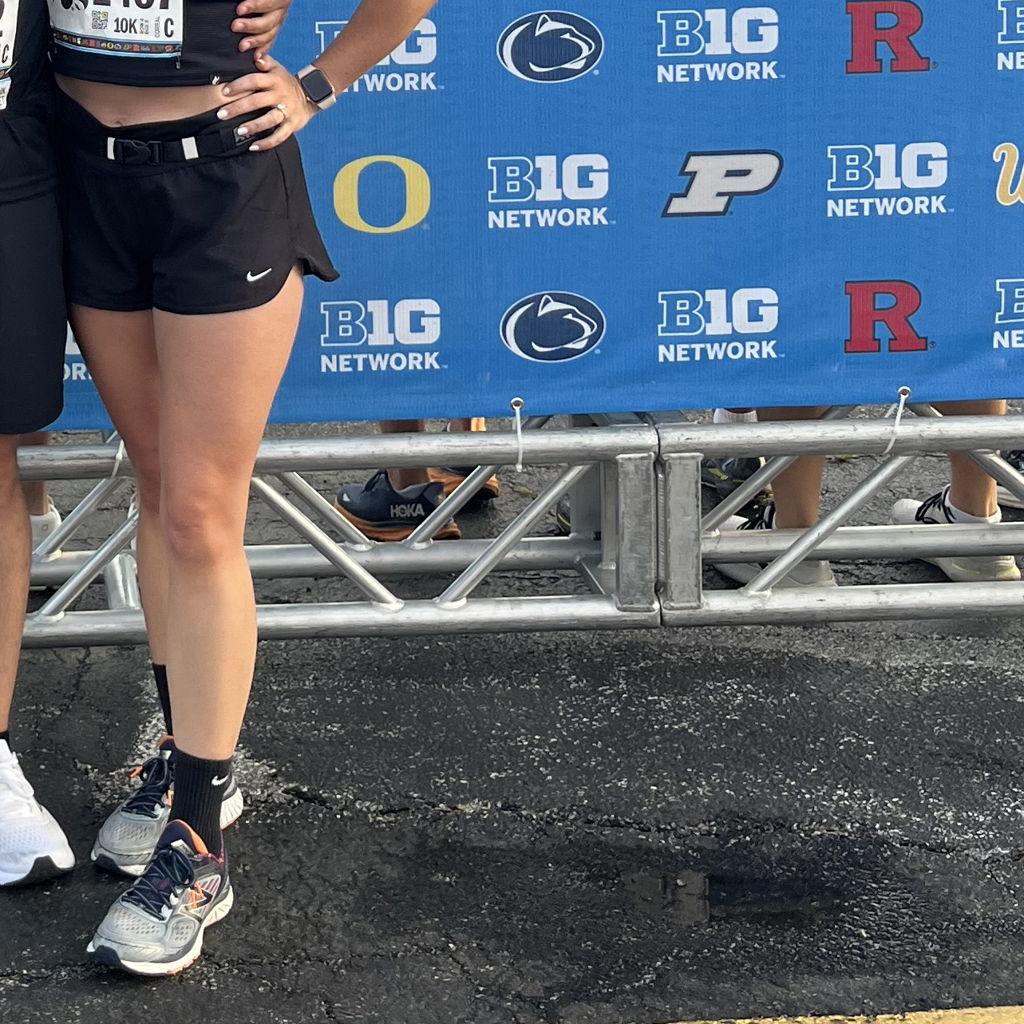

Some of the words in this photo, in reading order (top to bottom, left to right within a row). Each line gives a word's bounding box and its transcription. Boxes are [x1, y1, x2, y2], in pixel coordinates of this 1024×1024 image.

[114, 17, 137, 34] 10K
[164, 18, 174, 38] C
[845, 0, 931, 75] R
[343, 72, 437, 93] WORK
[658, 62, 777, 82] NETWORK
[664, 151, 782, 217] P
[332, 155, 432, 235] O
[828, 196, 946, 217] NETWORK
[489, 207, 608, 228] NETWORK
[844, 280, 930, 354] R
[659, 341, 776, 361] NETWORK
[321, 352, 439, 372] NETWORK
[390, 503, 425, 518] HOKA
